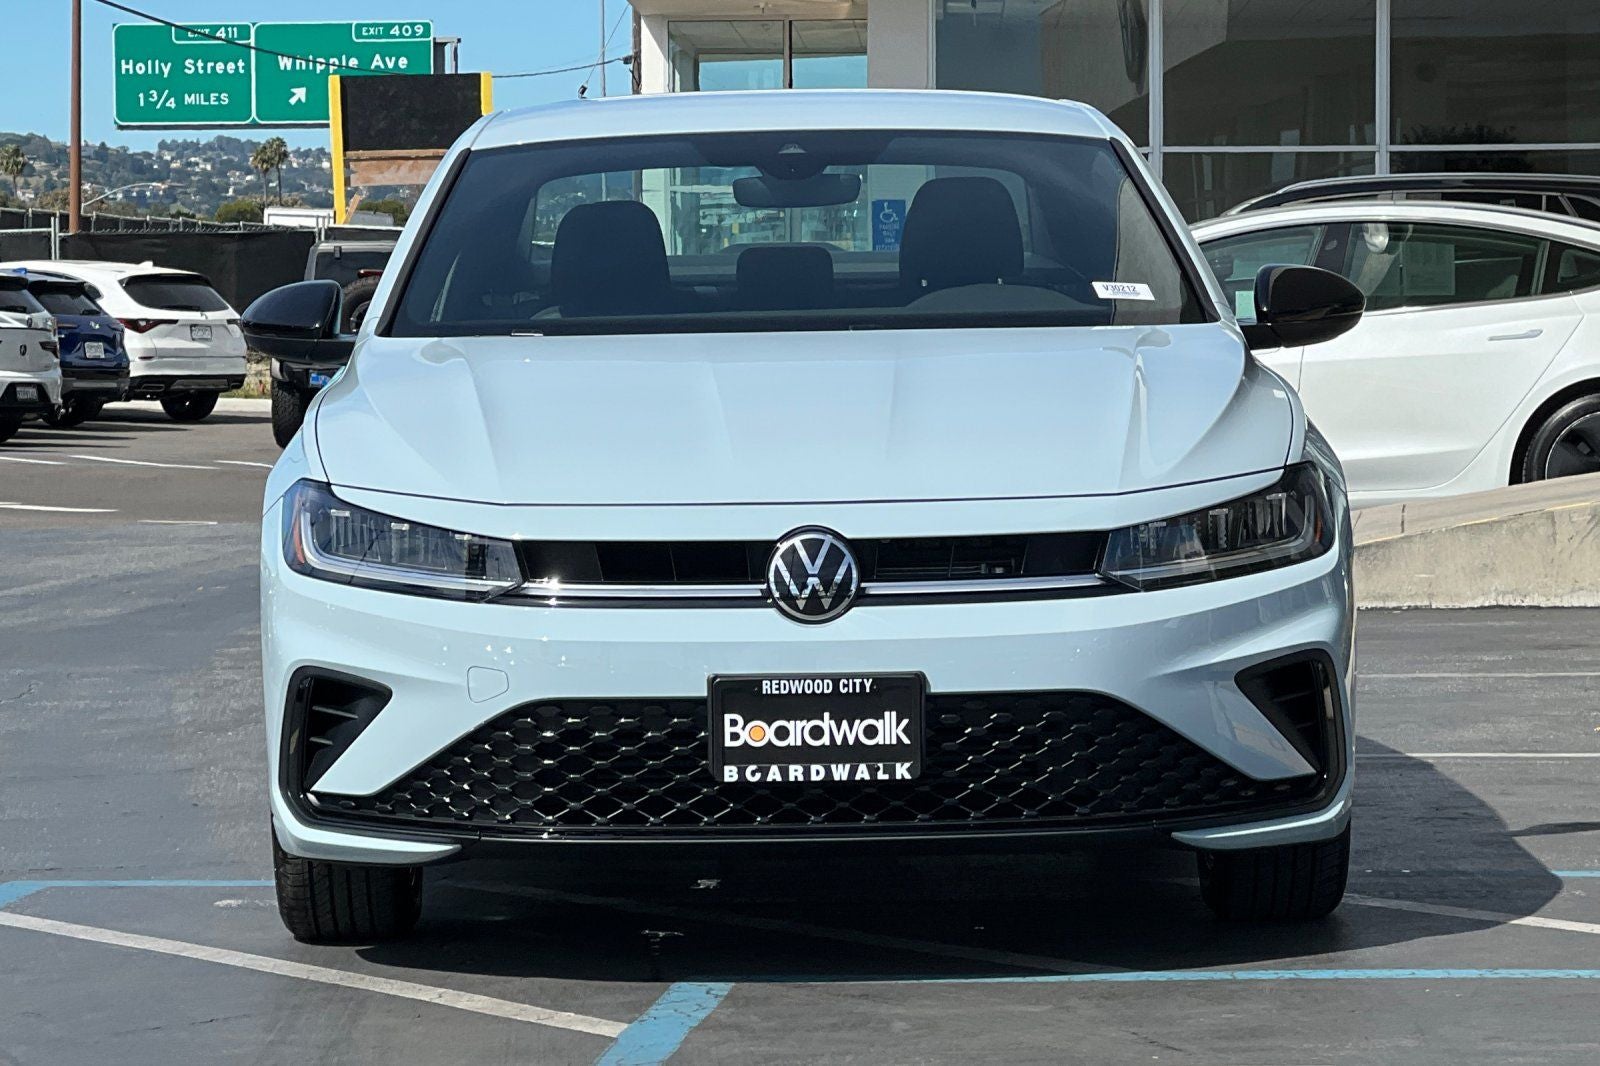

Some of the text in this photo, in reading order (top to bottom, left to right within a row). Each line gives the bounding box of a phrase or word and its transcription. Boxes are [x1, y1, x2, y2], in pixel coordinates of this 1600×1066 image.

[215, 26, 238, 39] 411
[362, 24, 424, 37] EXIT 409
[121, 58, 245, 78] Holly Street
[277, 53, 409, 74] Whipple Ave
[184, 93, 229, 105] MILES
[762, 678, 873, 695] REDWOOD CITY
[723, 710, 911, 747] Boardwalk
[723, 762, 913, 782] BOARDWALK
